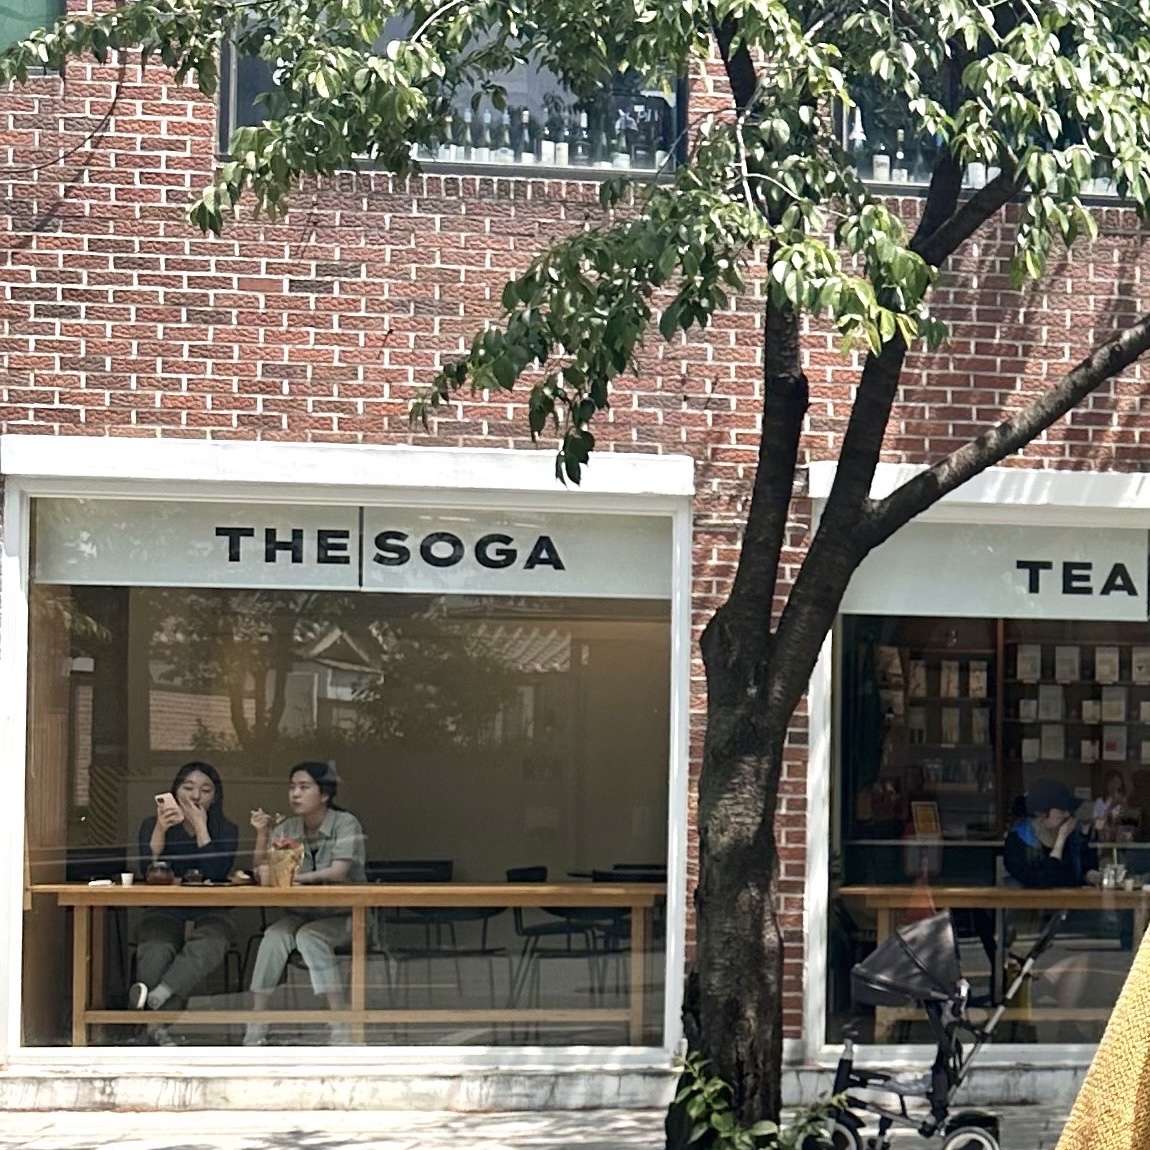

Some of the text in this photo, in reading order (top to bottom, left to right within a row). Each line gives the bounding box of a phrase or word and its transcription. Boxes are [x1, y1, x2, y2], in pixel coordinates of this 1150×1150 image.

[215, 527, 566, 571] THE SOGA
[1016, 560, 1138, 596] TEA
